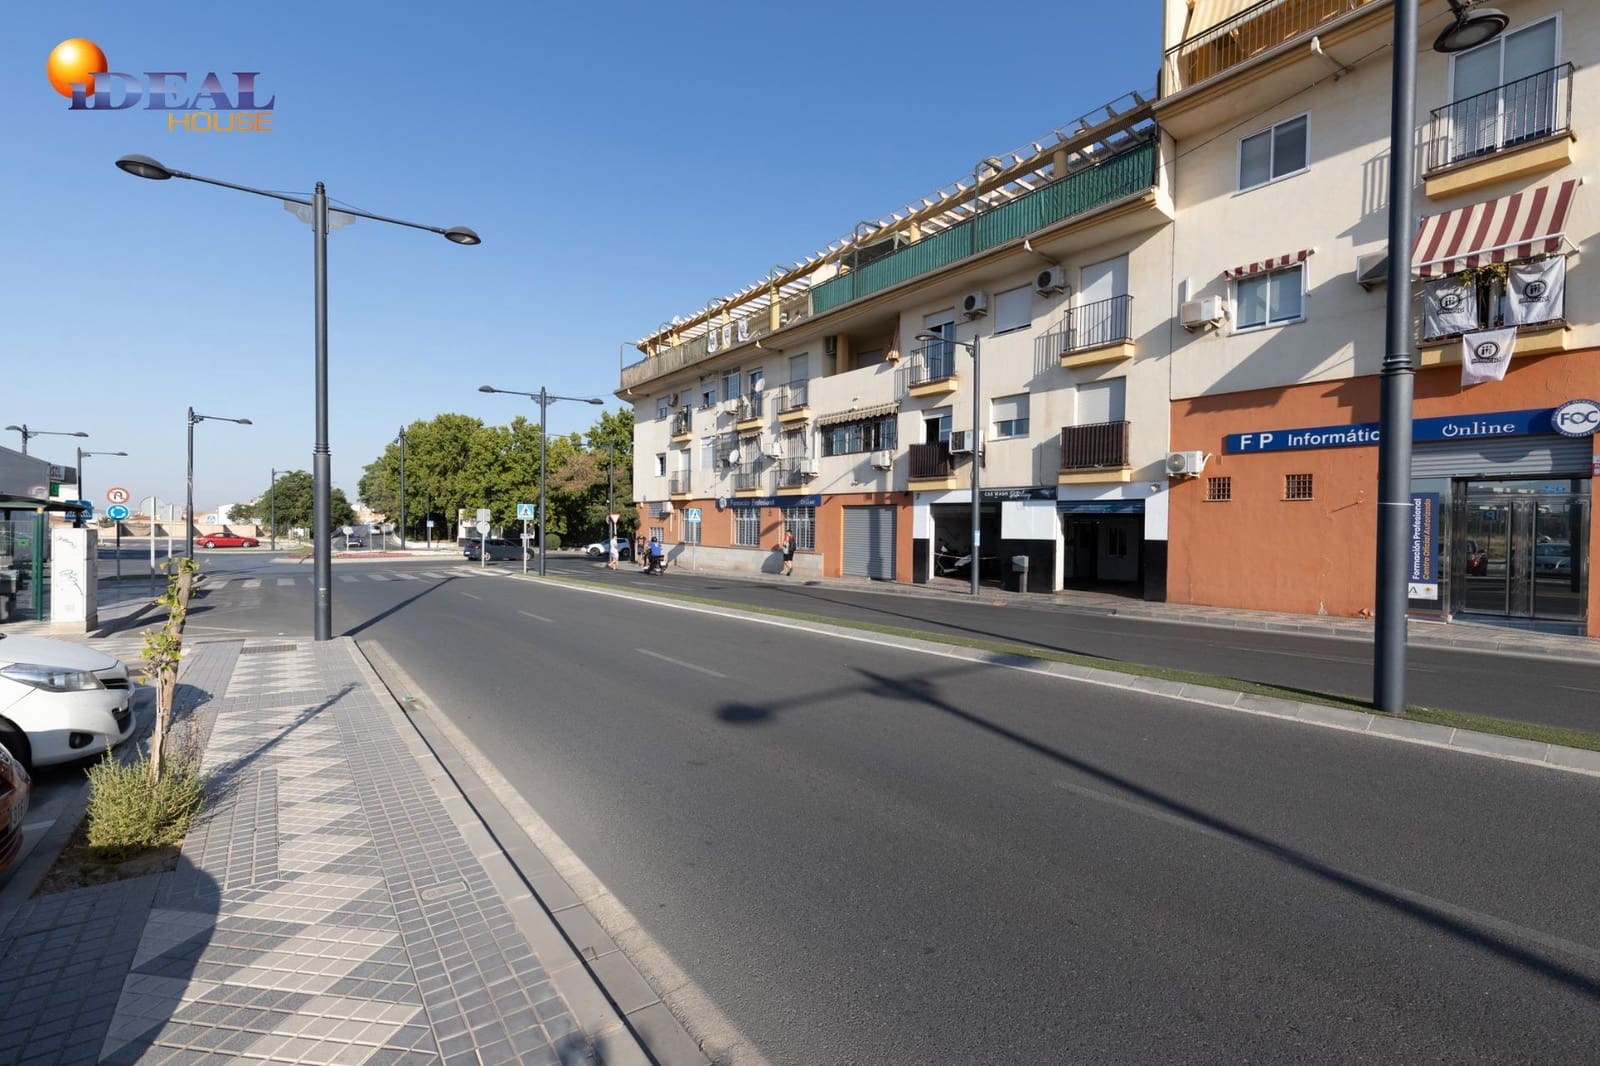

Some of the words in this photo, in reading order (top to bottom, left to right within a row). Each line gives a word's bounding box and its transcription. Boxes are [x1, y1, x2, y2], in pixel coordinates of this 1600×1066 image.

[1560, 410, 1598, 426] FOC
[1288, 428, 1380, 446] Informátic
[1413, 498, 1422, 538] Profesional
[1424, 498, 1432, 536] Autorizado
[1423, 536, 1431, 557] Oficial
[1412, 540, 1421, 580] Formación
[1422, 557, 1430, 580] Centro
